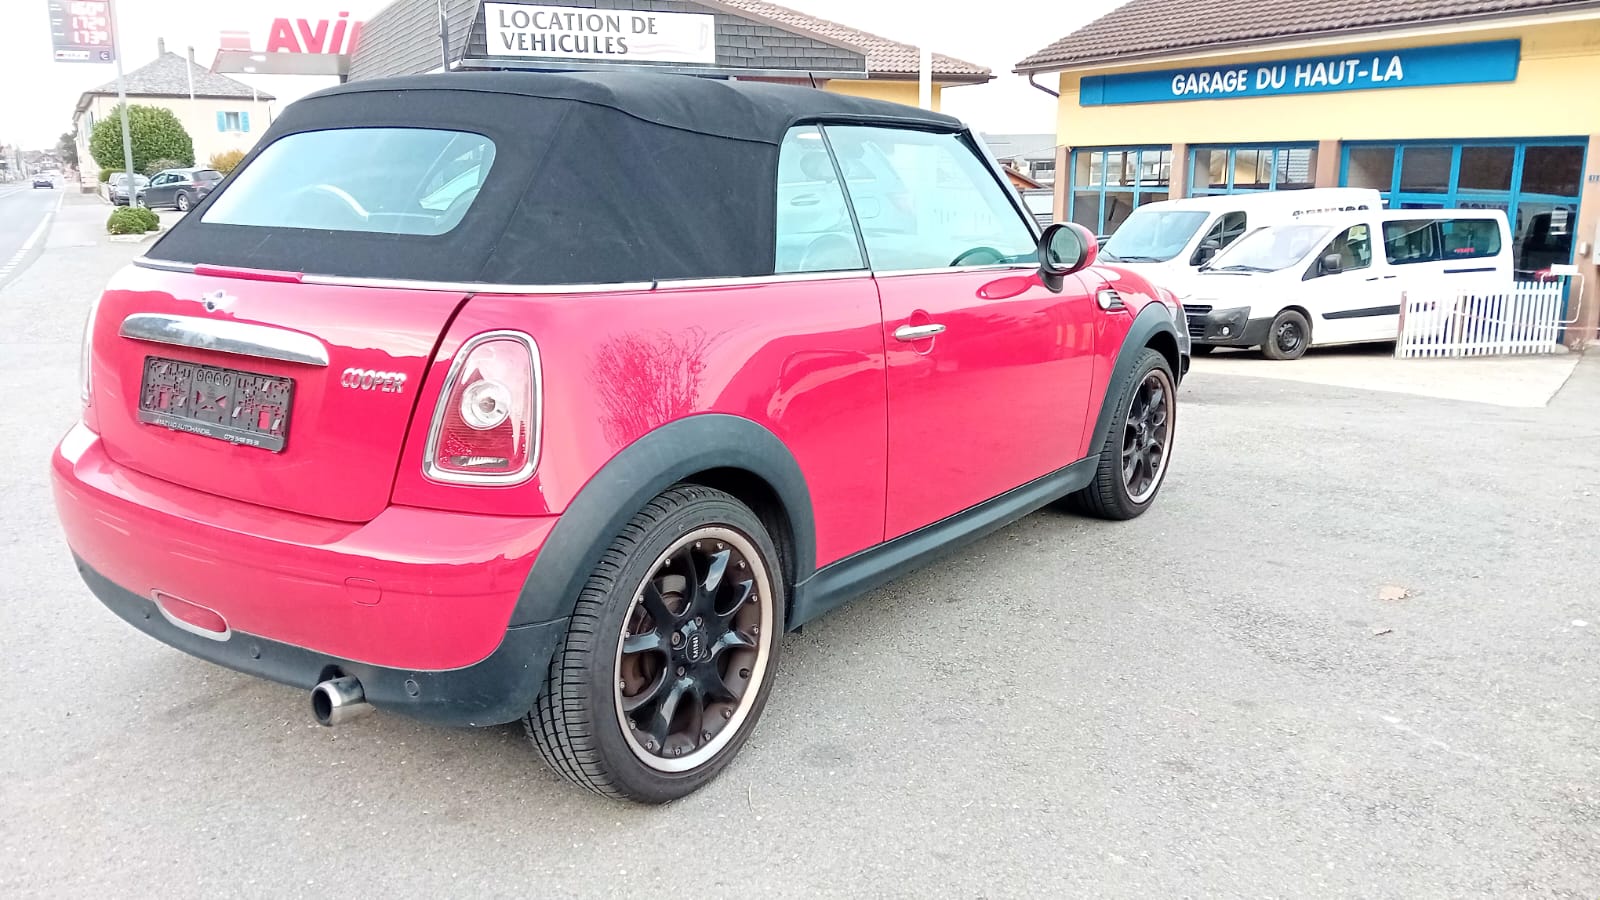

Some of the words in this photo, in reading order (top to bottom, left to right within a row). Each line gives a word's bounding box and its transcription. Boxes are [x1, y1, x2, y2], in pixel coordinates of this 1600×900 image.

[498, 9, 621, 34] LOCATION
[631, 16, 659, 36] DE
[500, 32, 629, 55] VEHICULES
[1171, 69, 1249, 96] GARAGE
[1255, 65, 1287, 90] DU
[1294, 55, 1404, 88] HAUT-LA
[341, 367, 407, 394] COOPER
